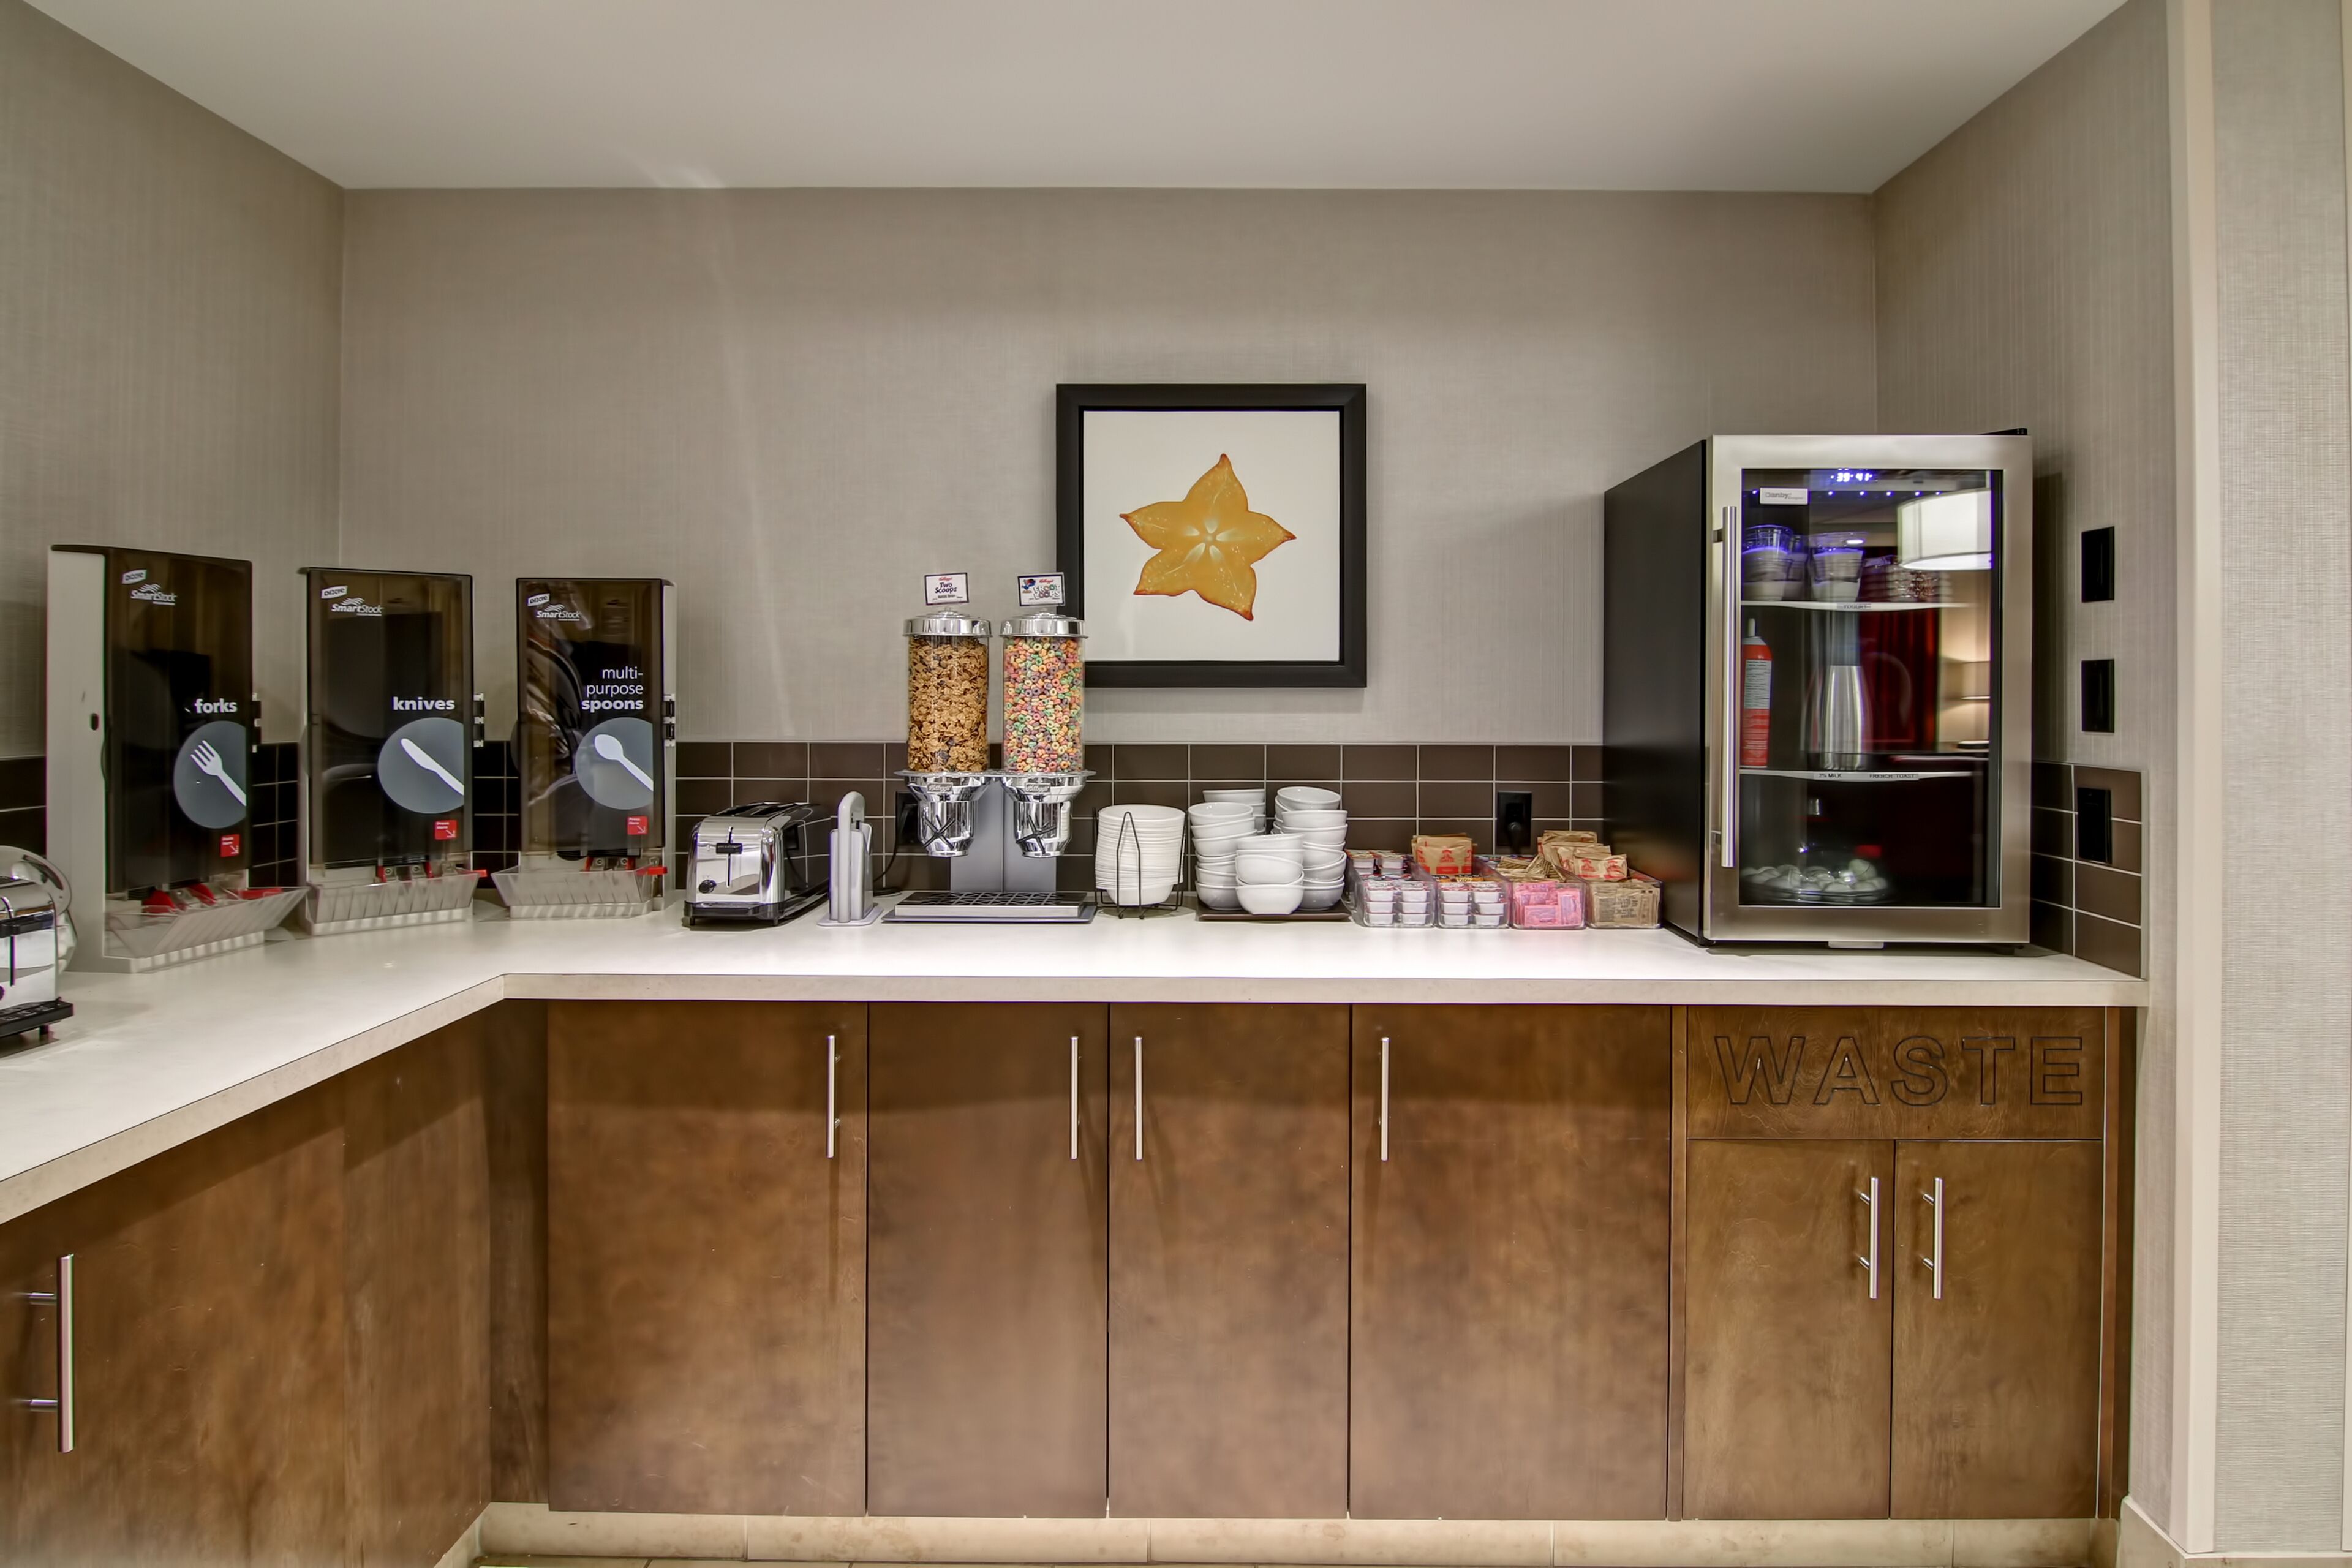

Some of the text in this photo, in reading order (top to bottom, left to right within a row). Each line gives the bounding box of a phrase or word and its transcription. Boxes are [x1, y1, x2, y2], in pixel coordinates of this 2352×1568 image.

[130, 590, 177, 601] SmartStock
[331, 603, 384, 613] SmartStock
[602, 666, 644, 679] multi-
[586, 685, 644, 698] purpose
[194, 698, 238, 714] forks
[393, 696, 456, 710] knives
[581, 699, 644, 713] spoons
[1715, 1036, 2082, 1106] WASTE
